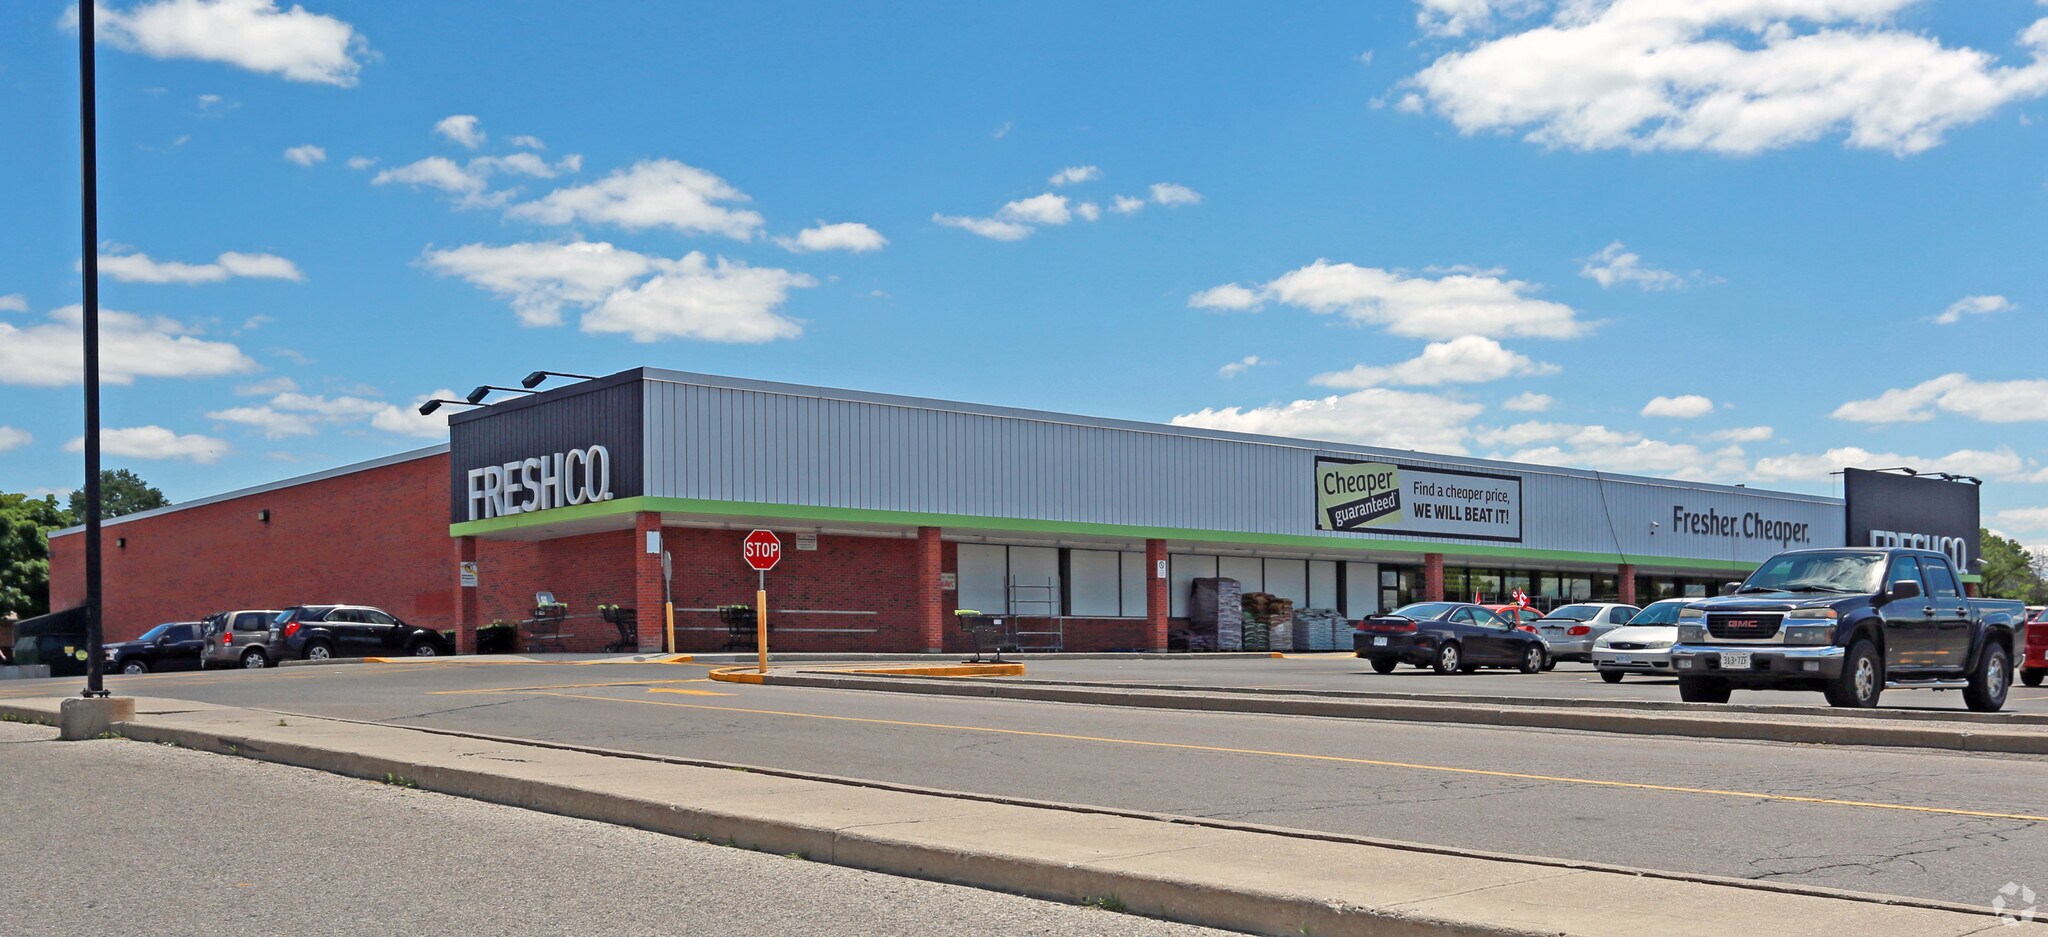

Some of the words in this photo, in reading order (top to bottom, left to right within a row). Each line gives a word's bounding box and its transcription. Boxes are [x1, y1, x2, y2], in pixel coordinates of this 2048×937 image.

[1323, 471, 1393, 497] Cheaper
[1413, 481, 1435, 497] Find
[1438, 486, 1443, 497] a
[1446, 487, 1484, 500] cheaper
[1485, 490, 1511, 504] price,
[1335, 492, 1396, 527] guaranteed
[1413, 502, 1432, 518] WE
[1434, 505, 1462, 520] WILL
[1465, 506, 1493, 522] BEAT
[1495, 509, 1509, 524] IT!
[1674, 505, 1740, 538] Fresher.
[1743, 512, 1811, 548] Cheaper.
[746, 541, 778, 557] STOP
[1728, 620, 1758, 628] GMC
